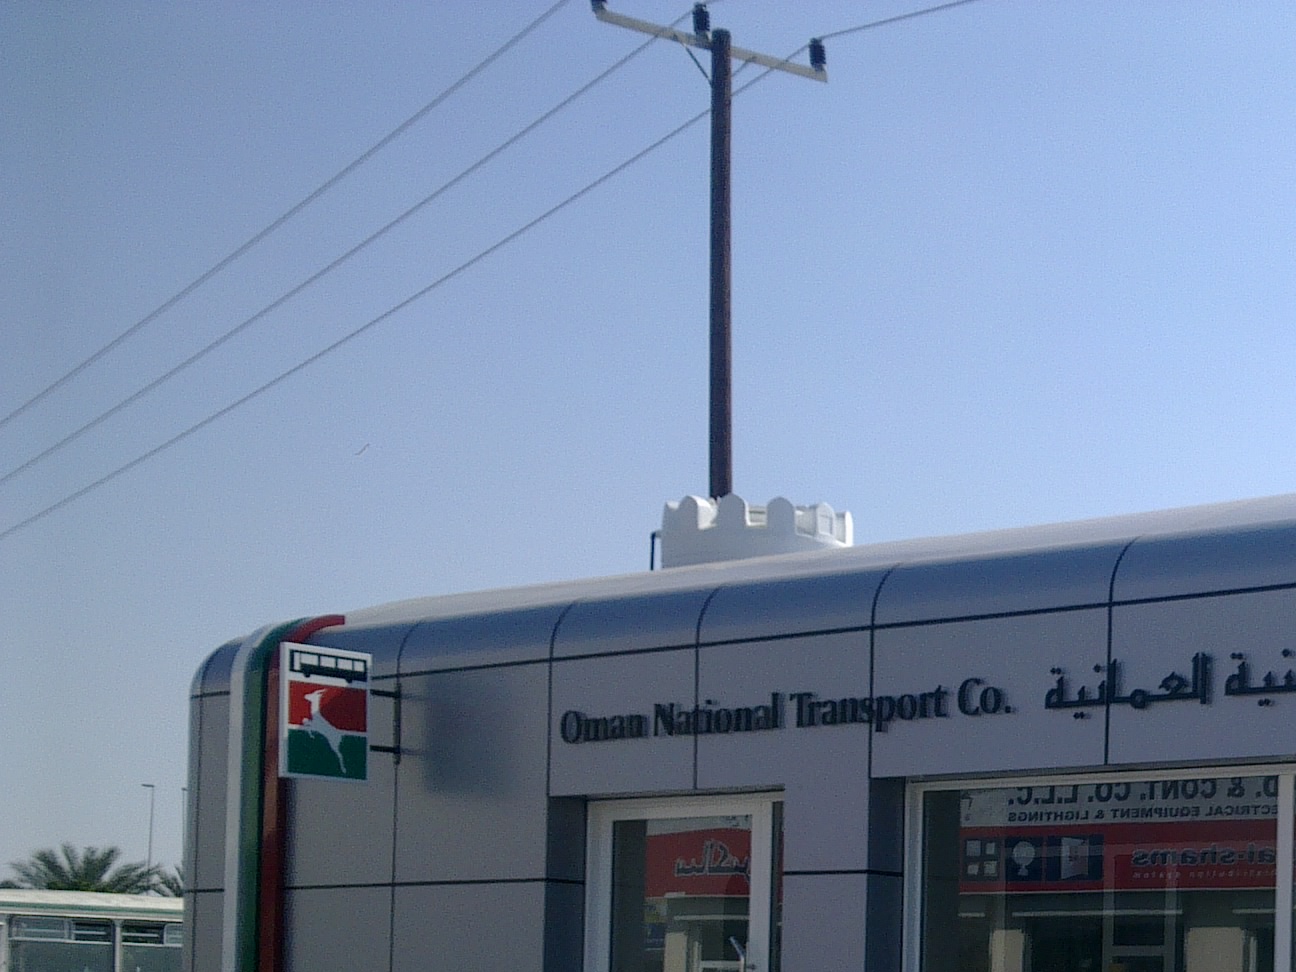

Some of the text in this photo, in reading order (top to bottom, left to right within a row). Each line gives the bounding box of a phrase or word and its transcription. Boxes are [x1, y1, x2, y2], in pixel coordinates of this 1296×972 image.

[559, 677, 1016, 744] Oman National Transport Co.
[1044, 651, 1211, 719] العمانية
